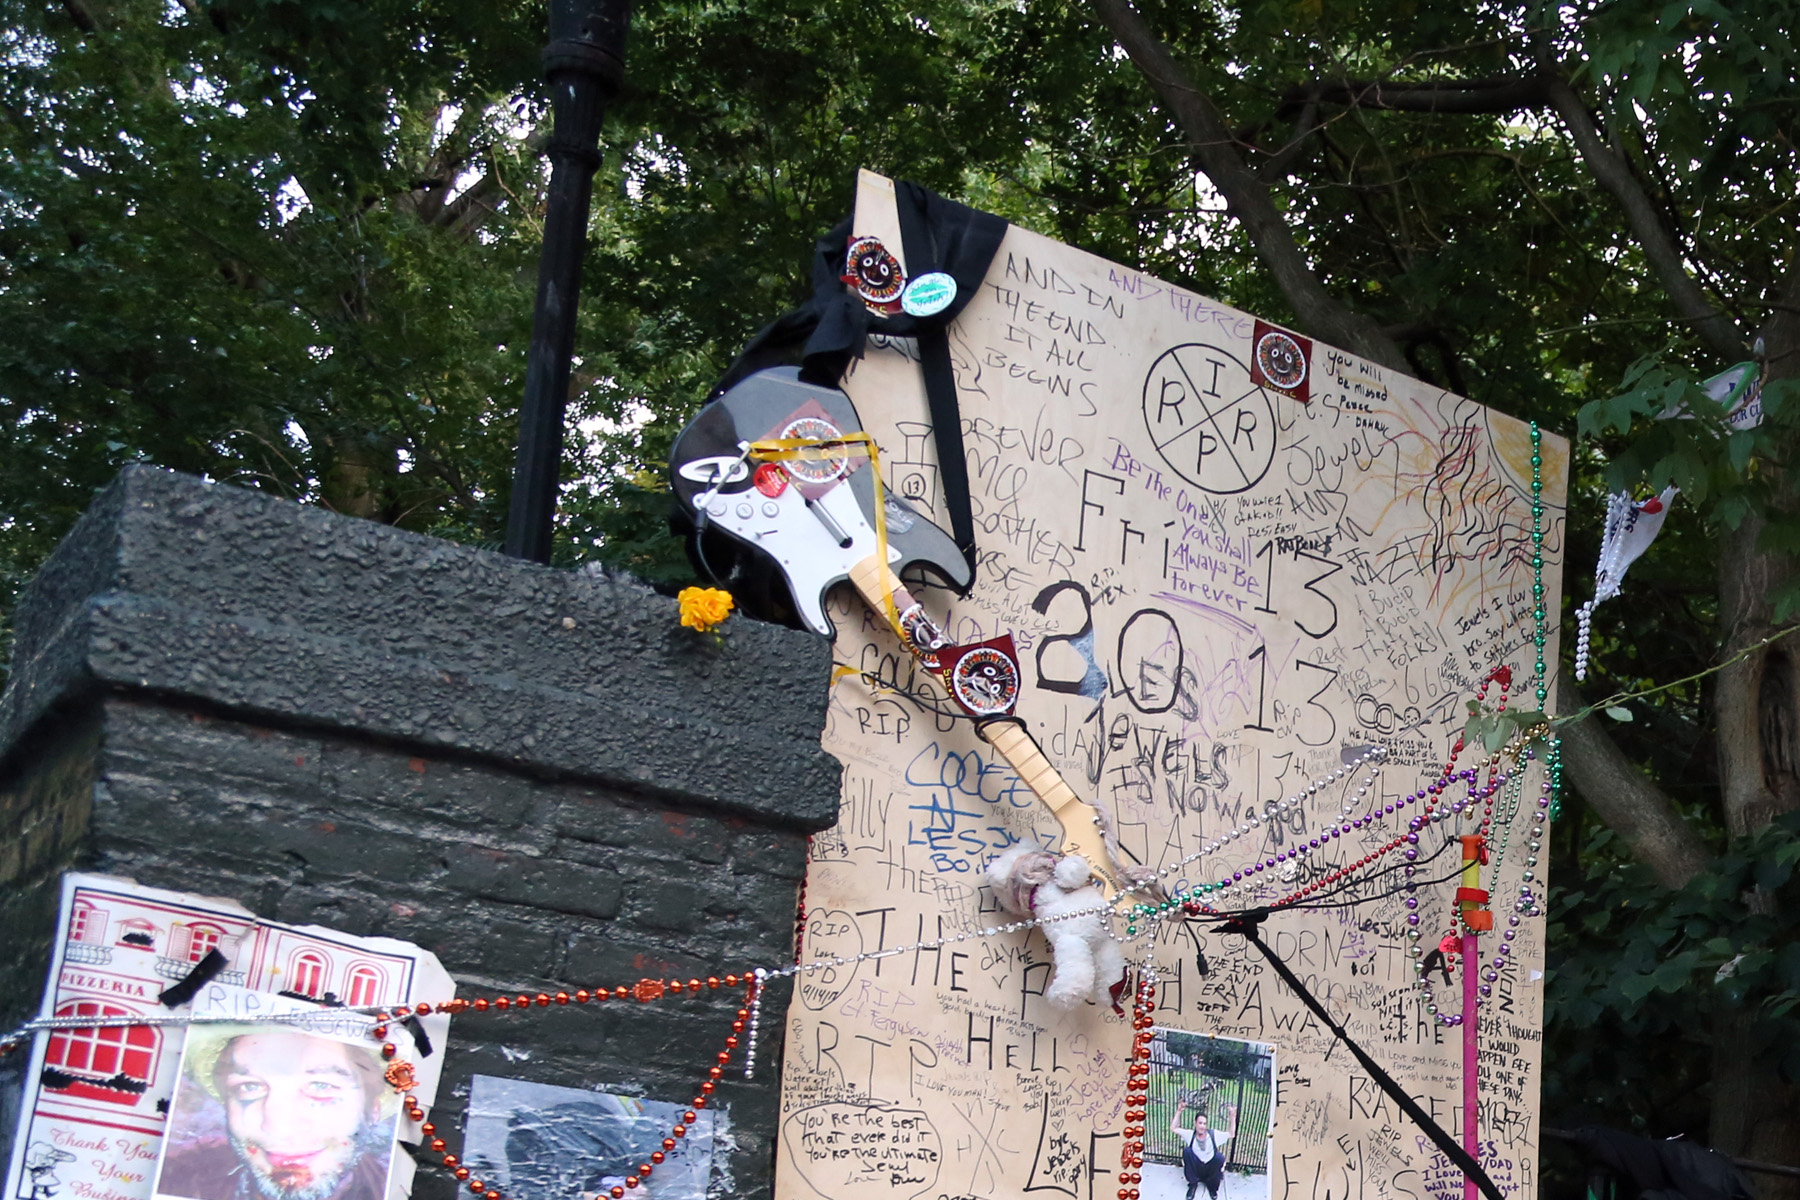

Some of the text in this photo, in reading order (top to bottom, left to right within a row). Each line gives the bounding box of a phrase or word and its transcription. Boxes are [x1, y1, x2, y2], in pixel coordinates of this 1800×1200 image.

[1003, 252, 1076, 295] AND
[1108, 268, 1163, 300] AND
[1046, 339, 1093, 372] ALL
[982, 346, 1098, 417] BEGINS
[61, 971, 146, 999] PIZZERIA
[50, 1127, 110, 1152] Thank
[91, 1159, 147, 1182] Your
